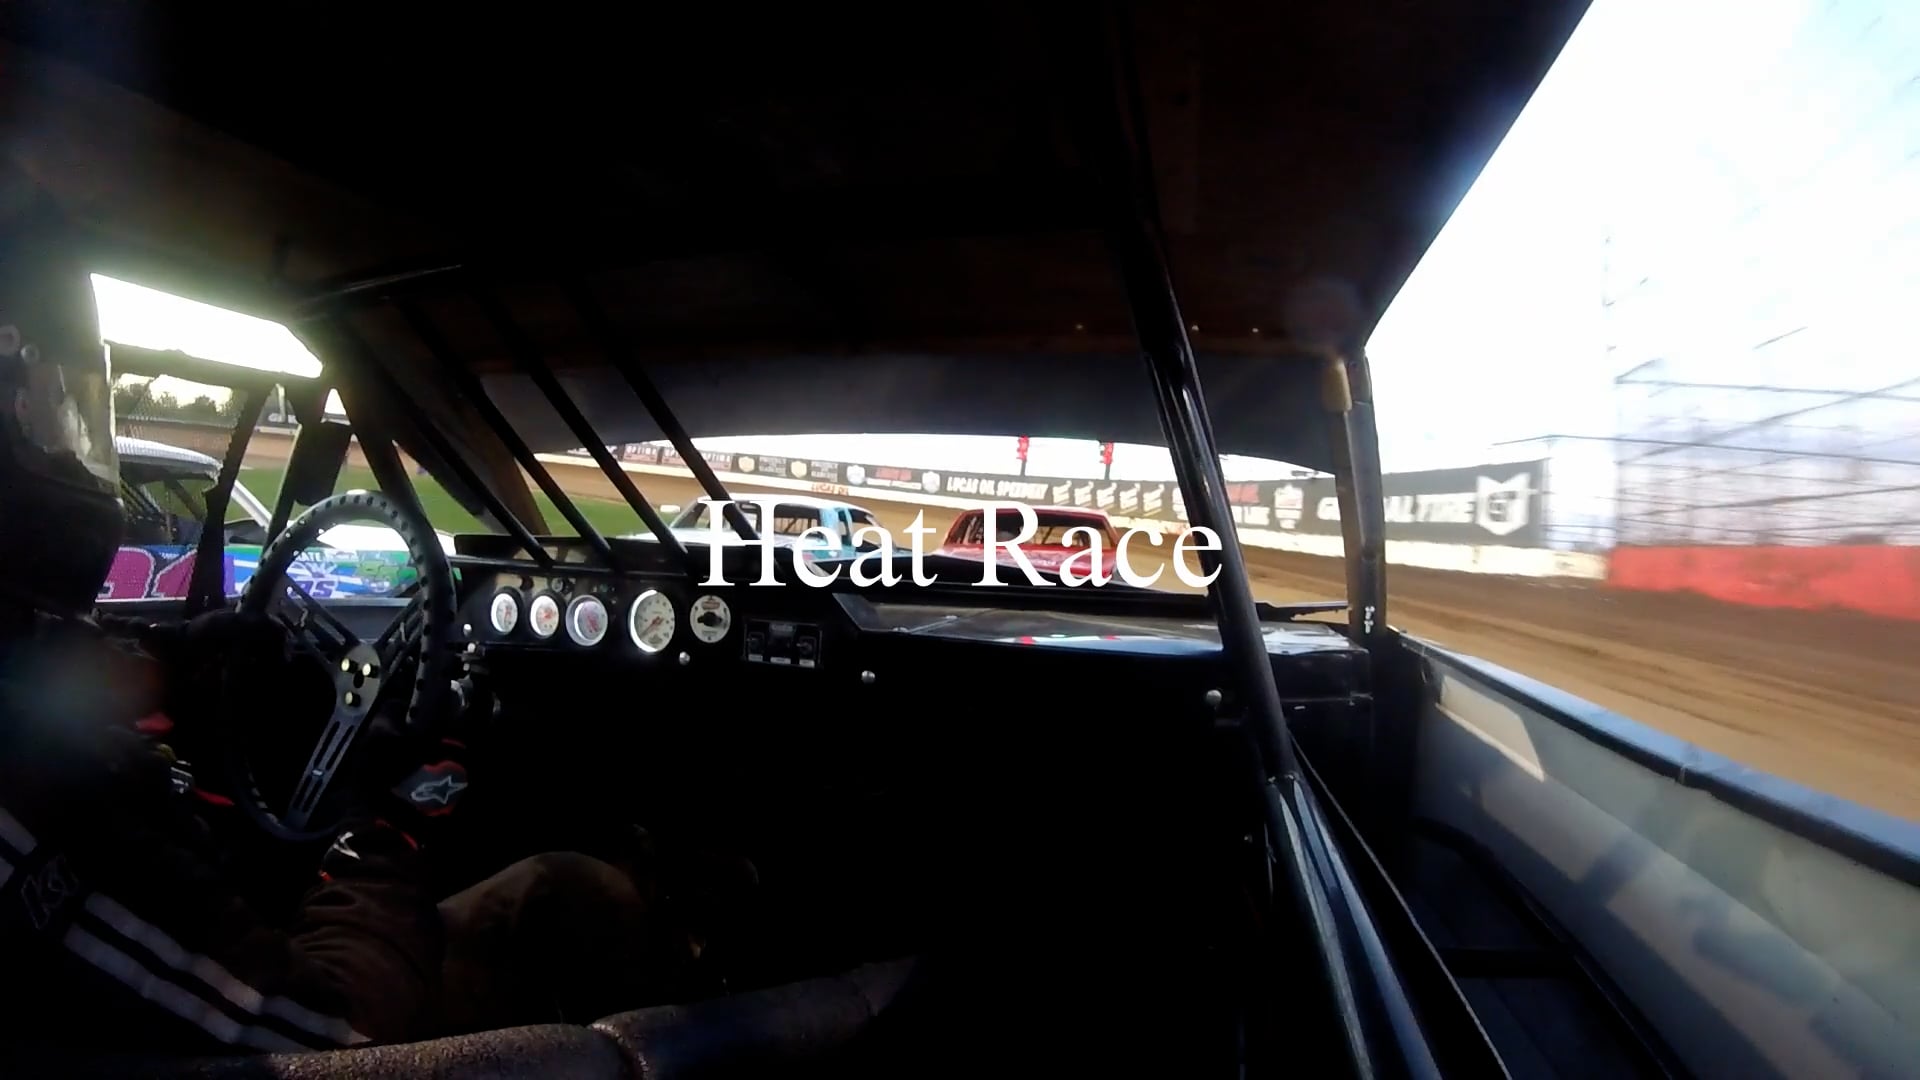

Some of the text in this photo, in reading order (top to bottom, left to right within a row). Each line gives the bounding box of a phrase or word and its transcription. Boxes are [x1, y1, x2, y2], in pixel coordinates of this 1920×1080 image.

[946, 476, 979, 494] LUCAS
[979, 479, 995, 496] OIL
[996, 480, 1049, 500] SPEEDWAY
